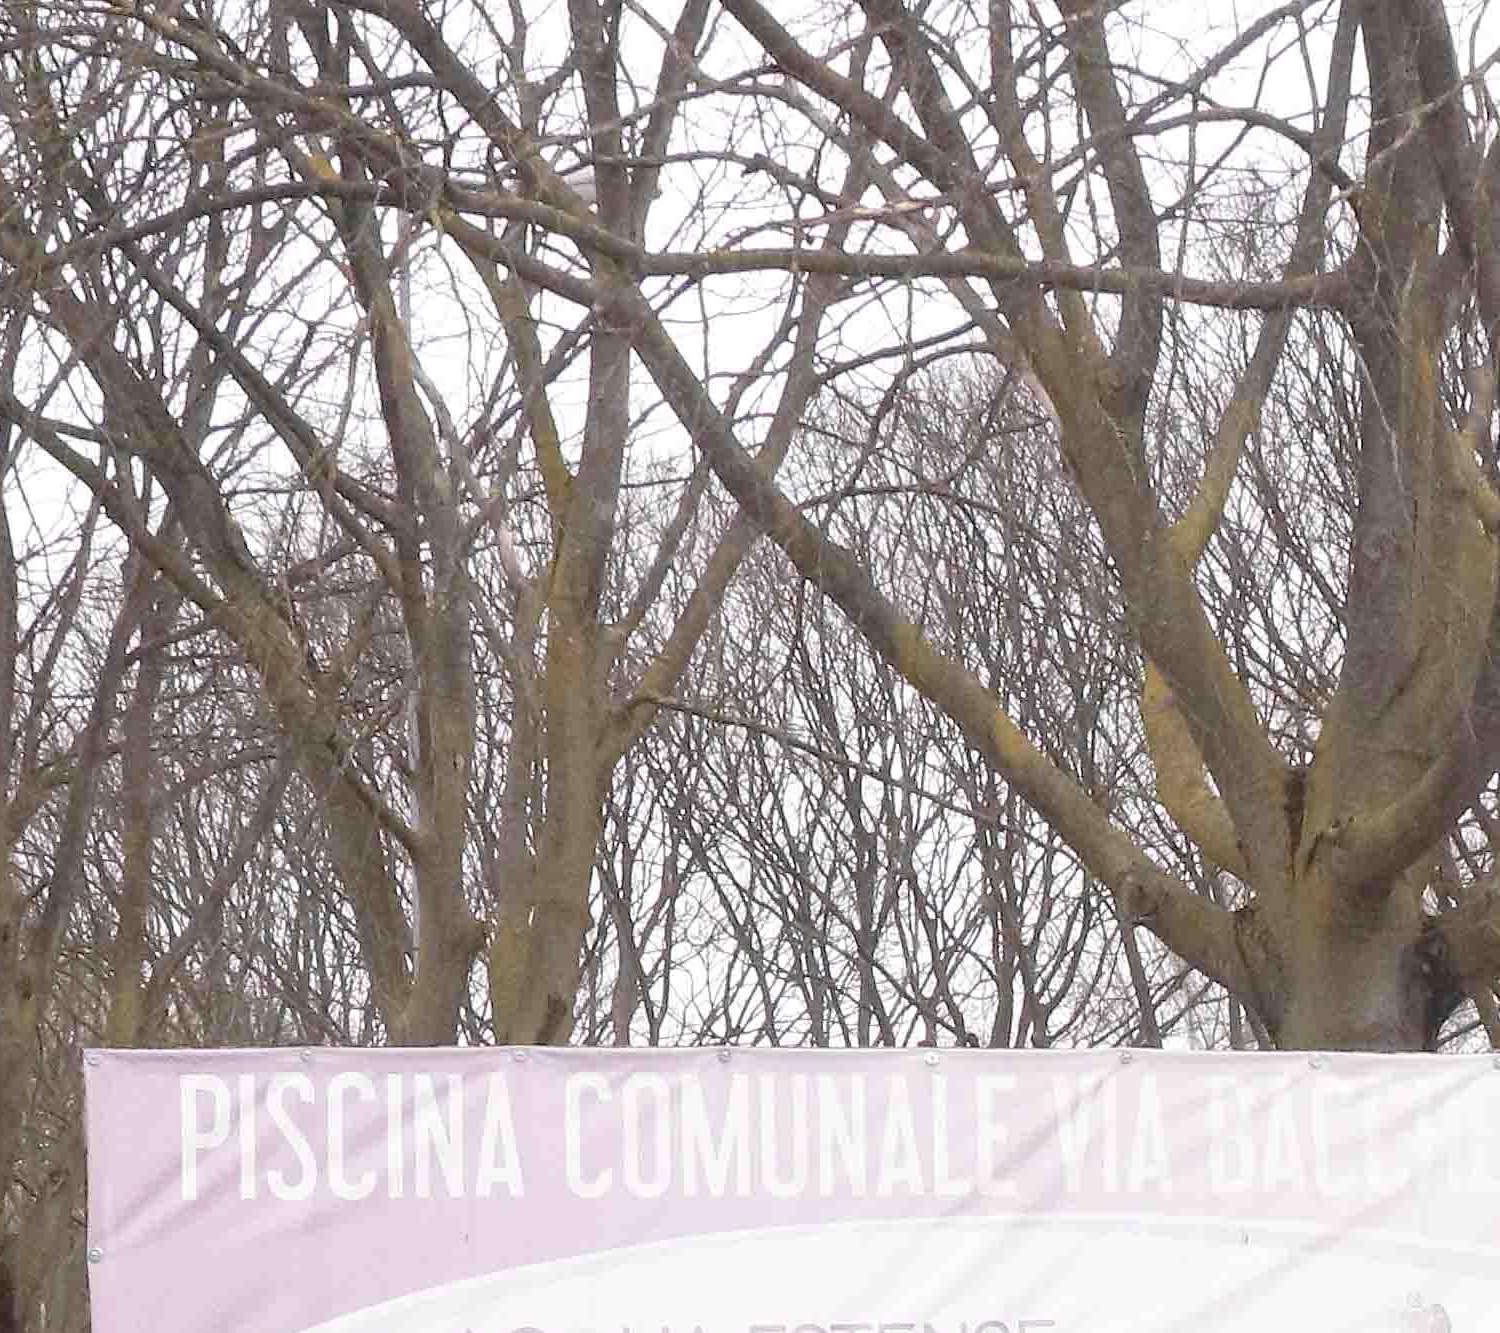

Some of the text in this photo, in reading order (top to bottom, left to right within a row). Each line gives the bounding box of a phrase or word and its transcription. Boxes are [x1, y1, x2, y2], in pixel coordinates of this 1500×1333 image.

[180, 1071, 525, 1201] PISCINA
[564, 1071, 1019, 1200] COMUNALE
[1054, 1073, 1173, 1193] VIA
